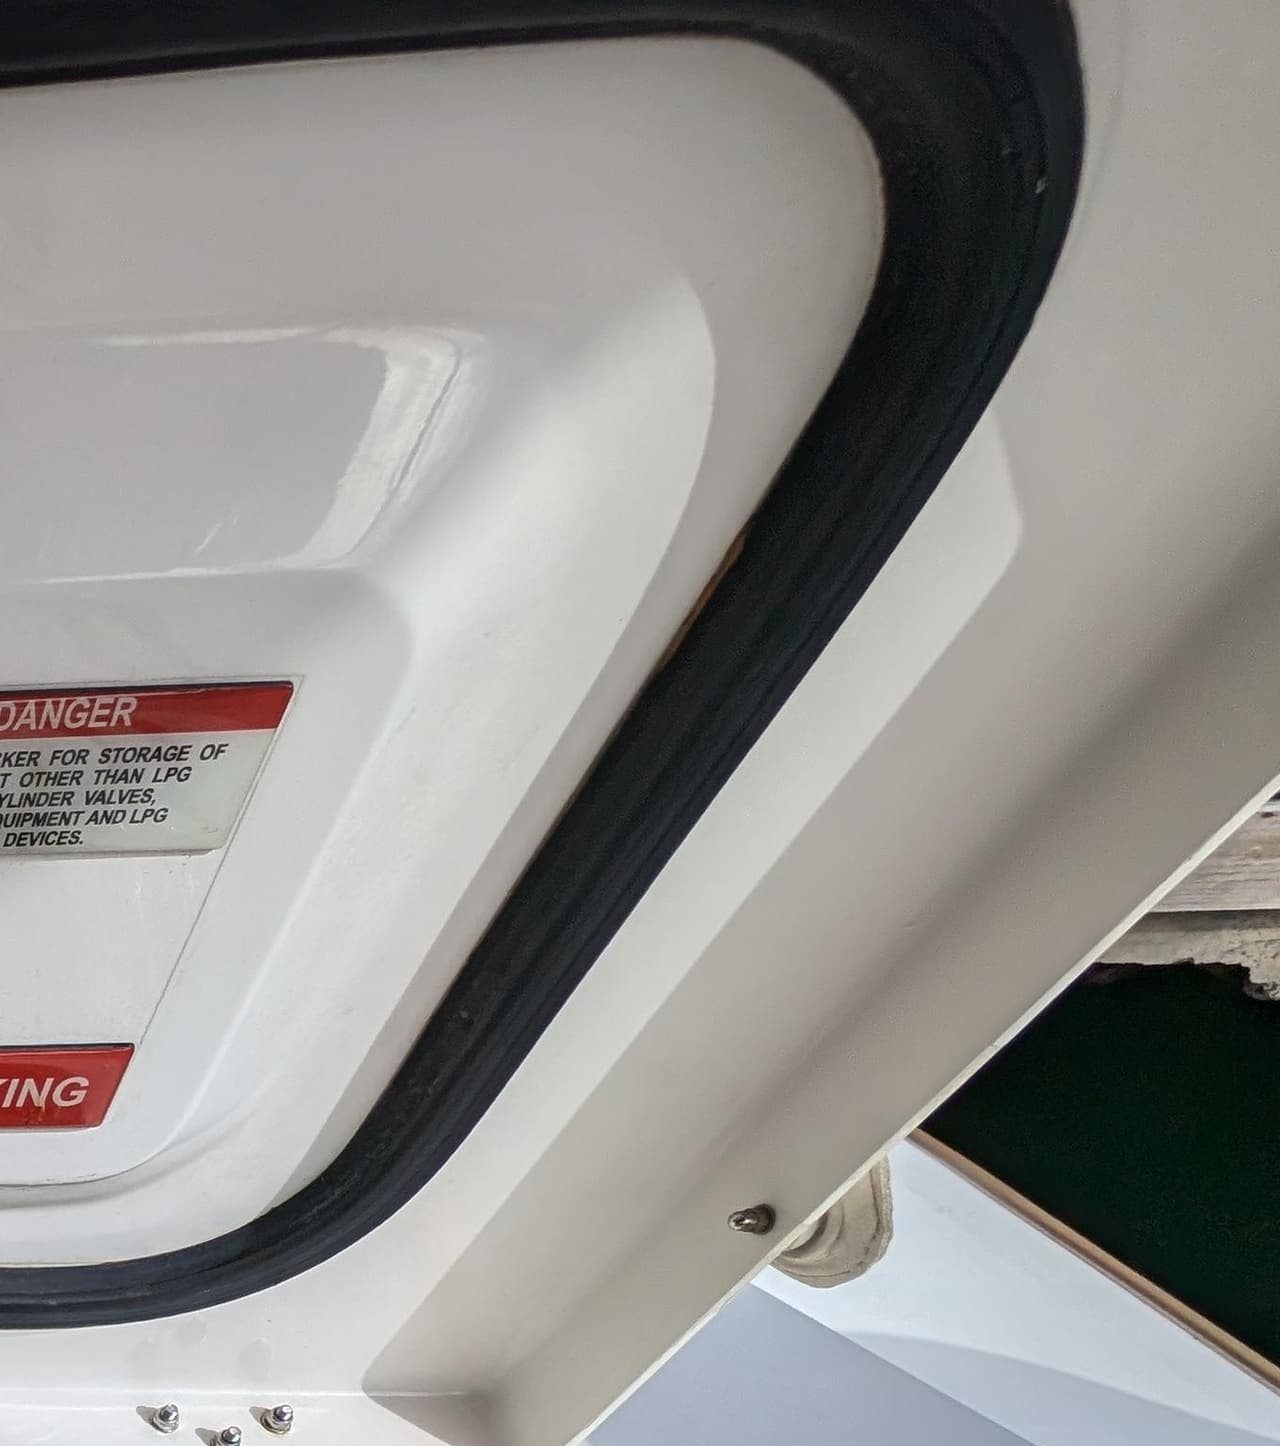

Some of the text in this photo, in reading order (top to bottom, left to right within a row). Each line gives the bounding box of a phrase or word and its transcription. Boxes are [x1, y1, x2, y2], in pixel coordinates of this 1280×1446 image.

[49, 749, 90, 766] FOR
[98, 745, 192, 764] STORAGE
[199, 743, 229, 761] OF
[19, 770, 84, 788] OTHER
[94, 768, 146, 785] THAN
[151, 766, 192, 783] LPG
[85, 788, 156, 806] VALVES,
[84, 810, 127, 825] AND
[129, 808, 169, 824] LPG
[3, 830, 83, 847] DEVICES.
